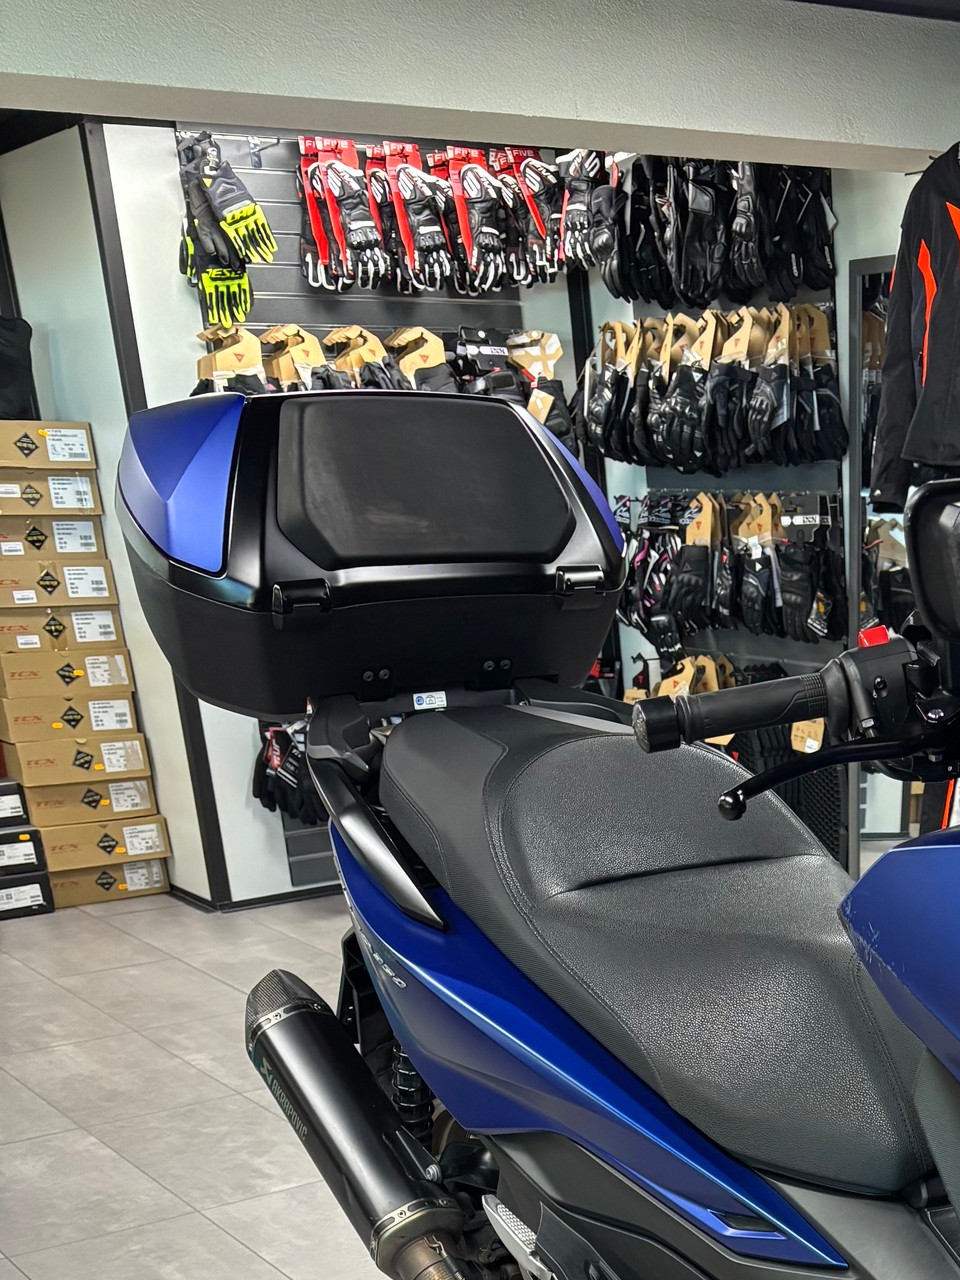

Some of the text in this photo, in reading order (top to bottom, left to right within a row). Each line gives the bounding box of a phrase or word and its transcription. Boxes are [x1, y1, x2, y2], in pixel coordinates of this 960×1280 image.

[323, 139, 348, 149] FIVE
[513, 149, 534, 157] FIVE
[27, 758, 56, 766] TCX
